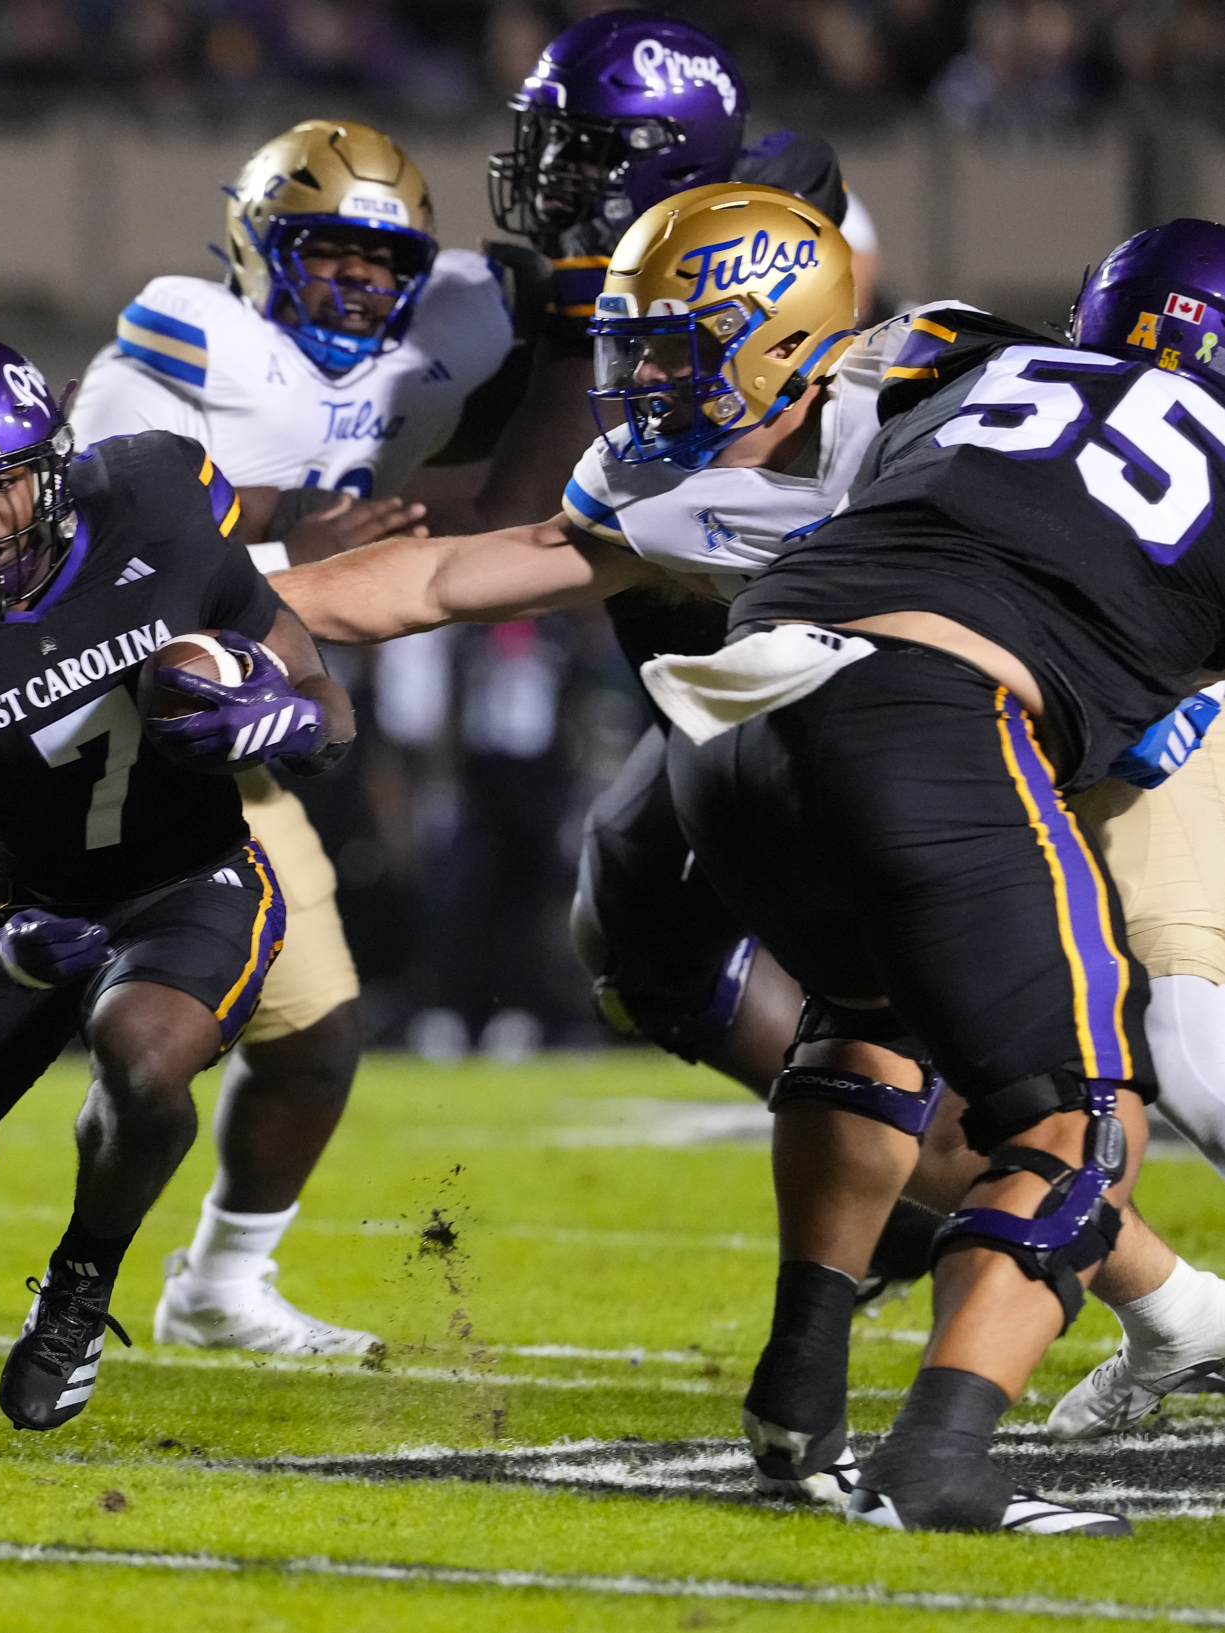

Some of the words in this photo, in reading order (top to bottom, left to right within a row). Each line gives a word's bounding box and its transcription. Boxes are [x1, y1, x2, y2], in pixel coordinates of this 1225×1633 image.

[682, 229, 820, 303] Tulsa
[1159, 347, 1181, 371] 55
[933, 345, 1225, 546] 55
[25, 618, 174, 709] CAROLINA
[30, 684, 142, 850] 7
